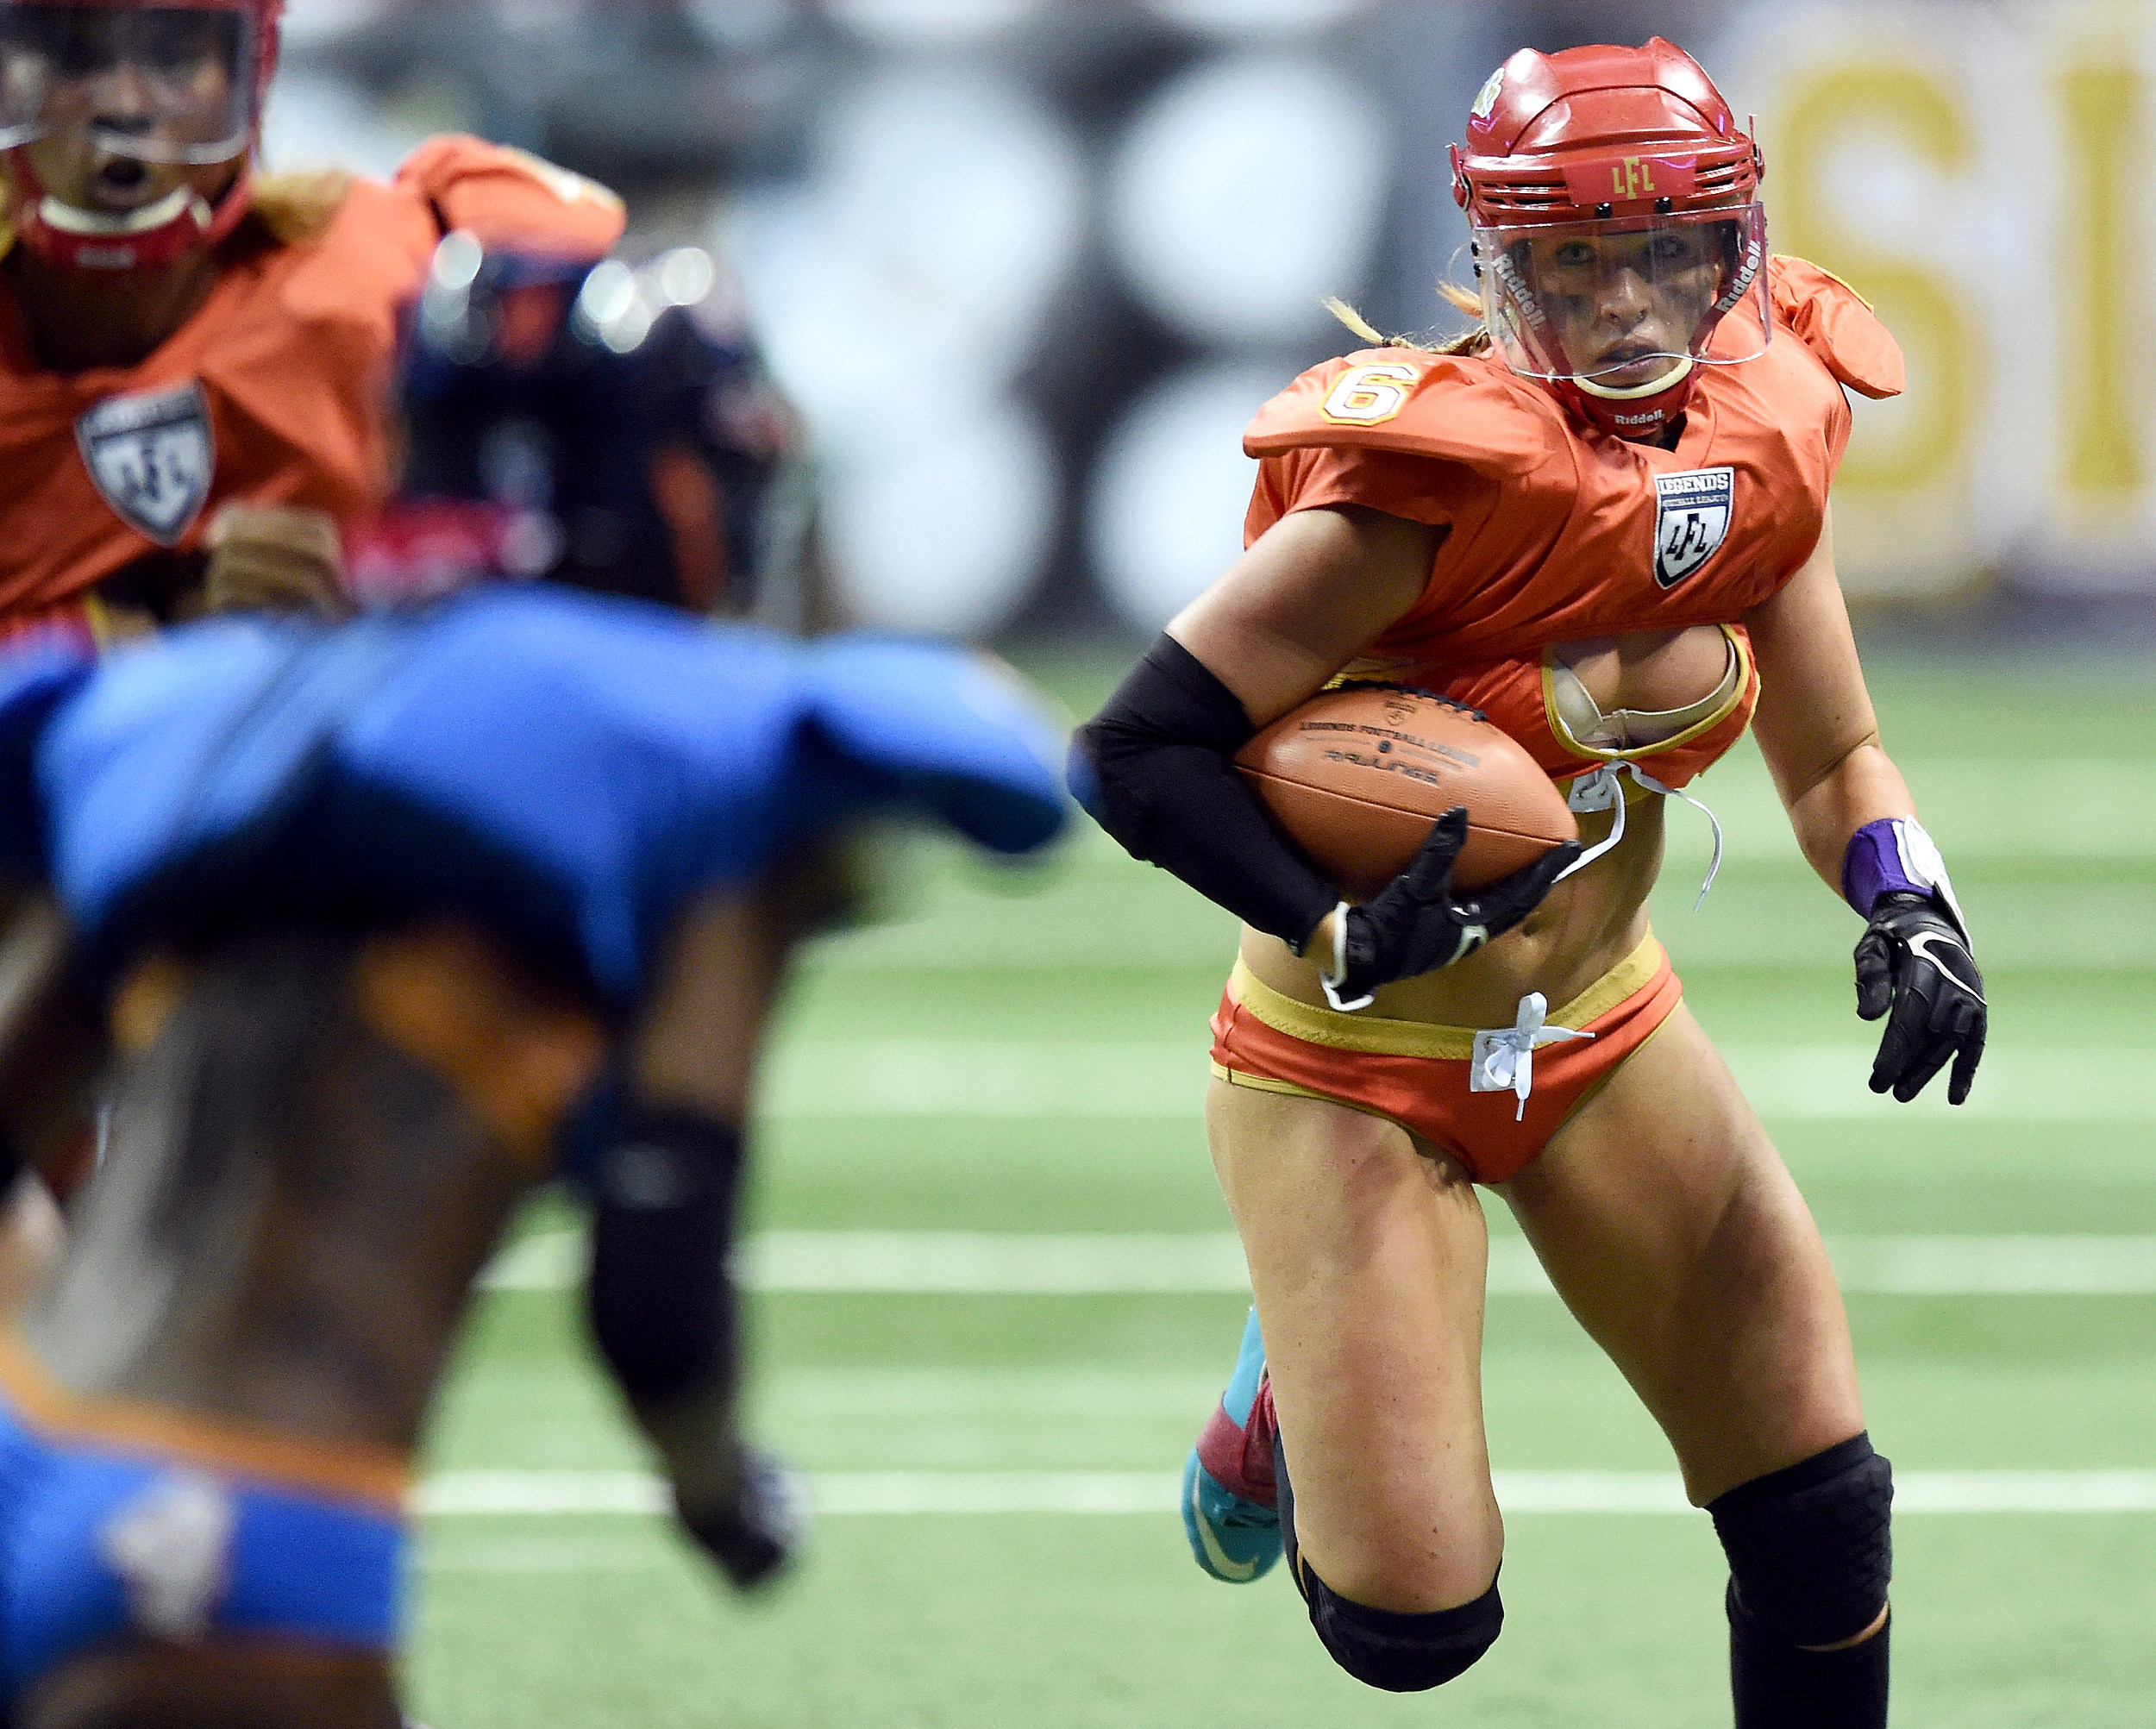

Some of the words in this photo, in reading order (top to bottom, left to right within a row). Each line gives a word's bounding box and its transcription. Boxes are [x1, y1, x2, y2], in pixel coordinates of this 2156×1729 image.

[1612, 157, 1655, 199] LFL
[1493, 253, 1546, 329] Riddell
[1714, 240, 1762, 312] Riddell
[1318, 361, 1421, 426] 6
[1614, 410, 1664, 425] Riddell
[1658, 474, 1729, 495] LEGENDS
[1666, 513, 1706, 561] LFL
